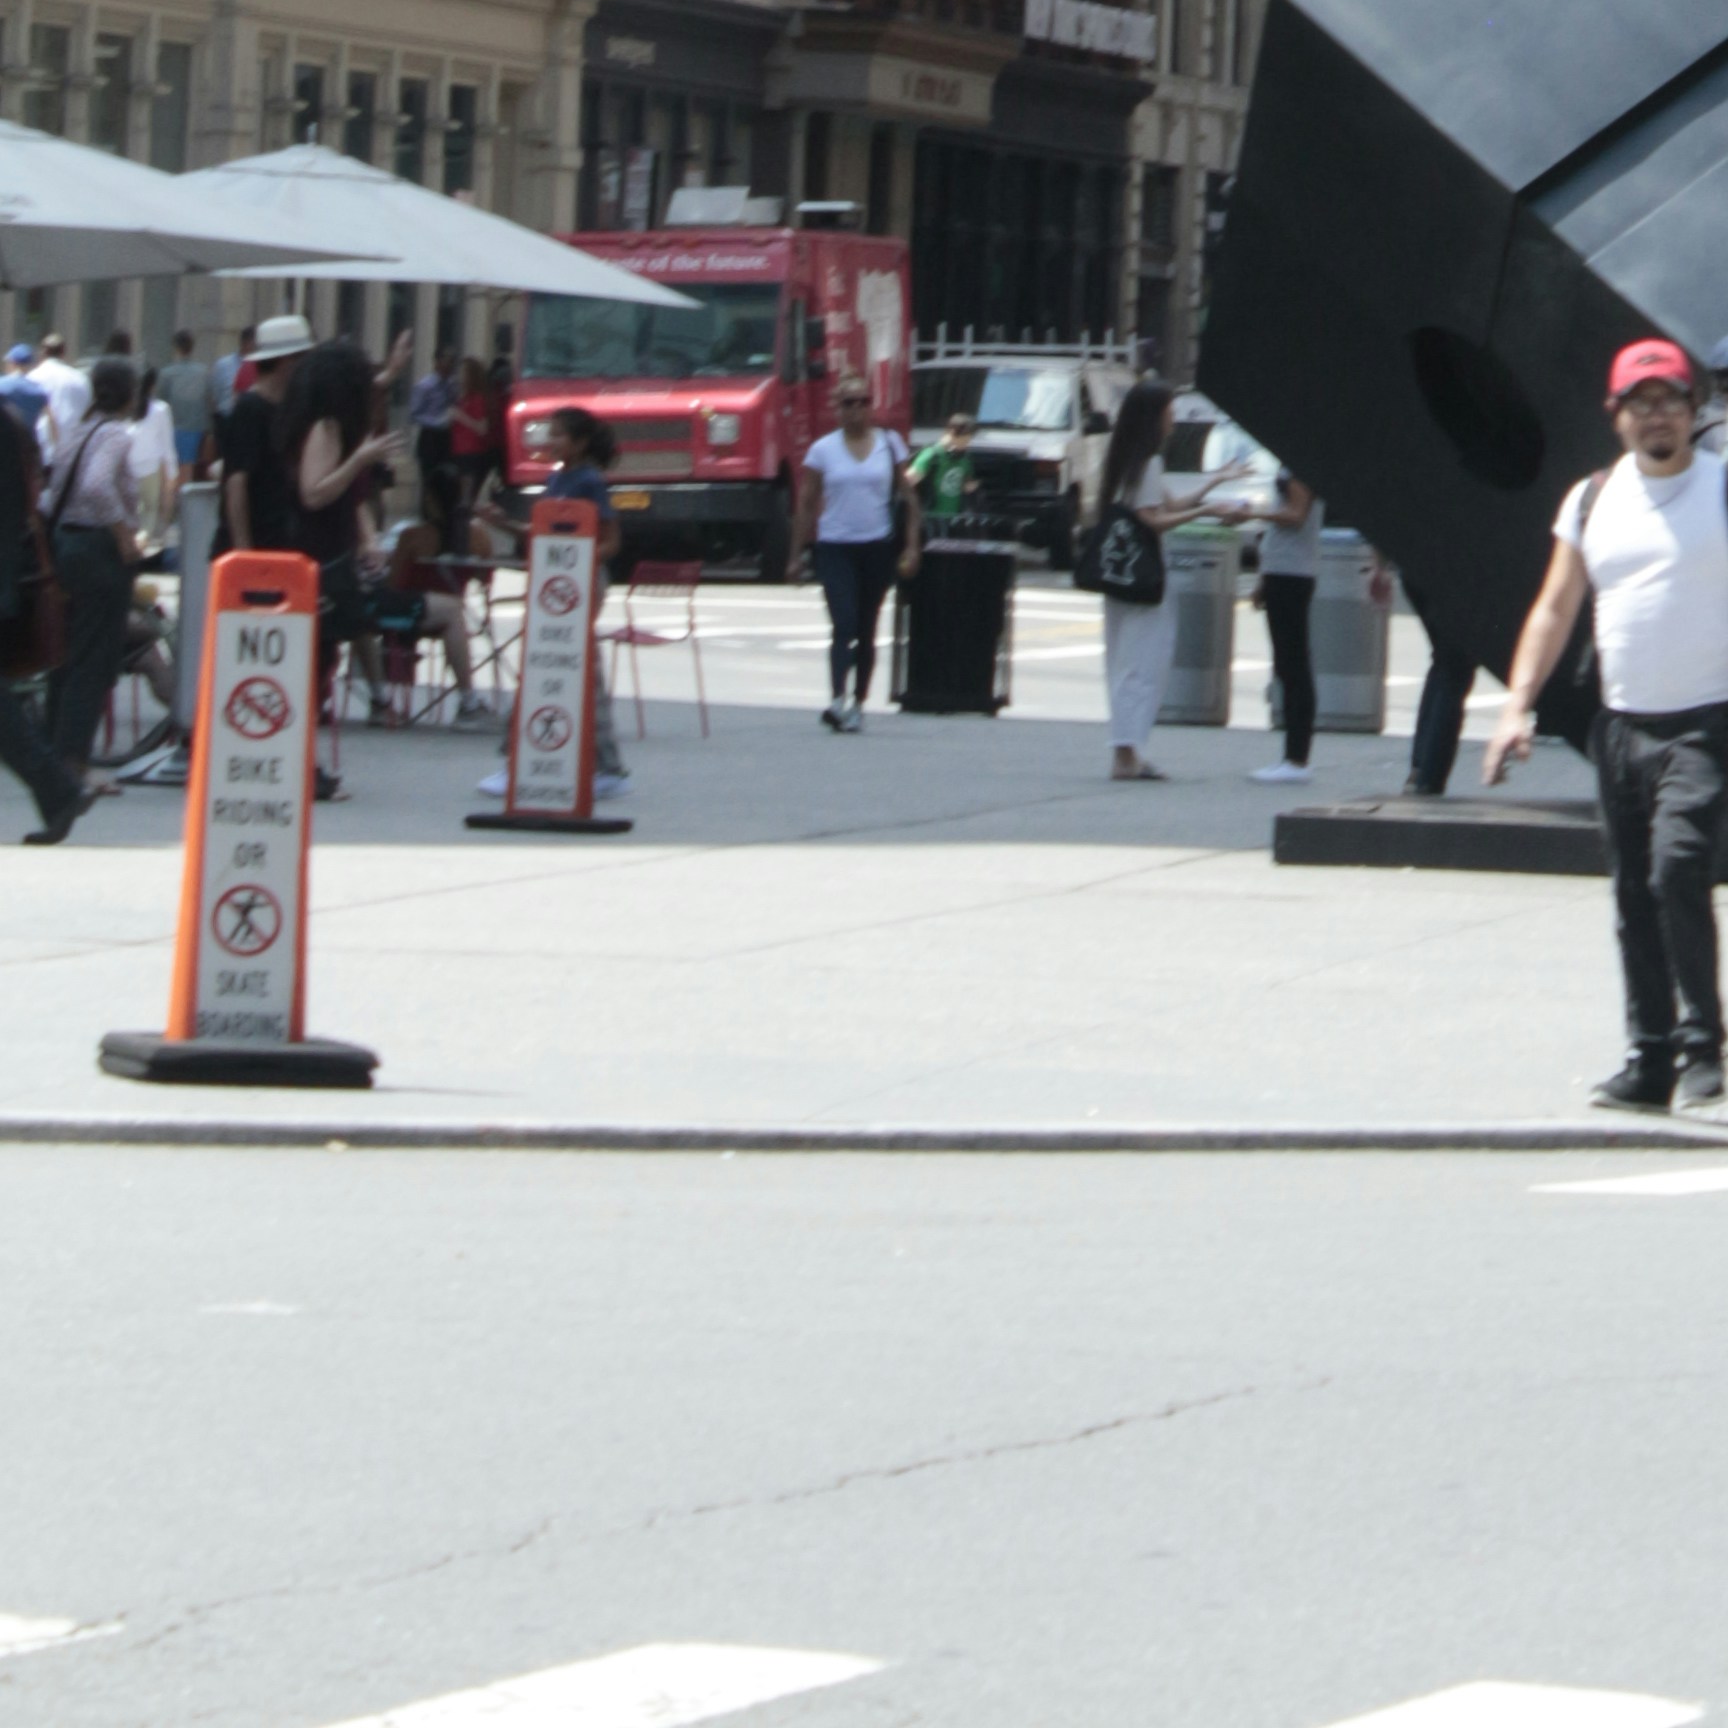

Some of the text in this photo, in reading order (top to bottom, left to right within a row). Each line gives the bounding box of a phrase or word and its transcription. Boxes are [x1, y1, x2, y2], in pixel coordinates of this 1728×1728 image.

[547, 546, 578, 570] NO
[237, 627, 286, 666] NO
[226, 754, 284, 785] BIKE
[212, 798, 293, 828] RIDING
[233, 842, 269, 869] OR
[216, 969, 270, 998] SKATE
